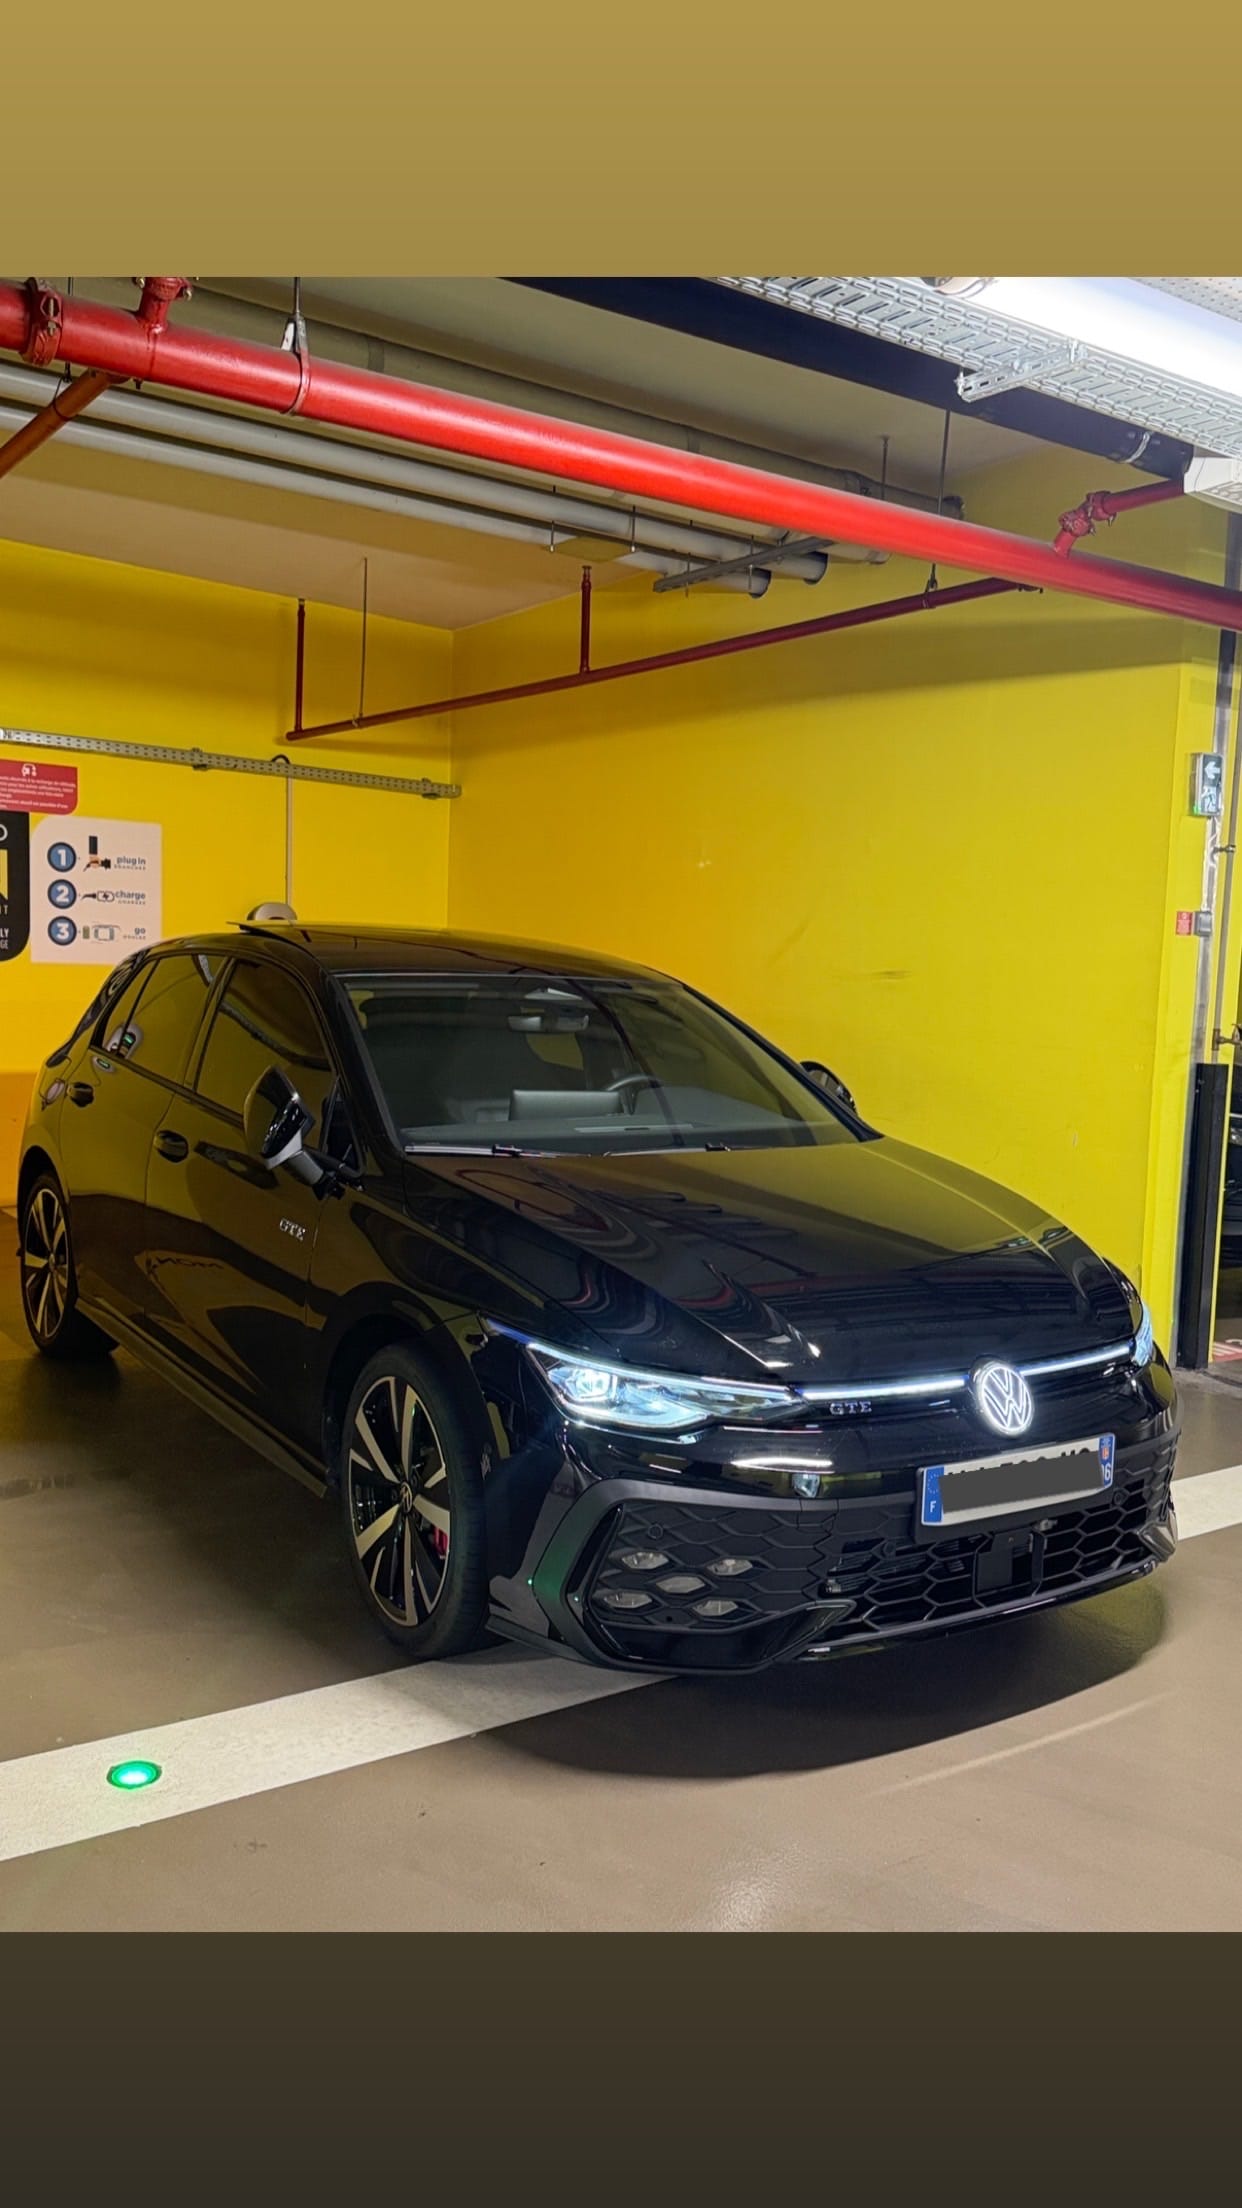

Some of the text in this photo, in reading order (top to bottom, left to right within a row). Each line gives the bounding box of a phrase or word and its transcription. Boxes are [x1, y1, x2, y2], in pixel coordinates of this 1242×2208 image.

[57, 848, 67, 867] 1
[55, 884, 70, 903] 2
[115, 890, 146, 901] charge
[56, 922, 70, 940] 3
[134, 927, 146, 936] go
[280, 1217, 306, 1241] GTE
[829, 1401, 872, 1415] GTE
[929, 1500, 937, 1513] F
